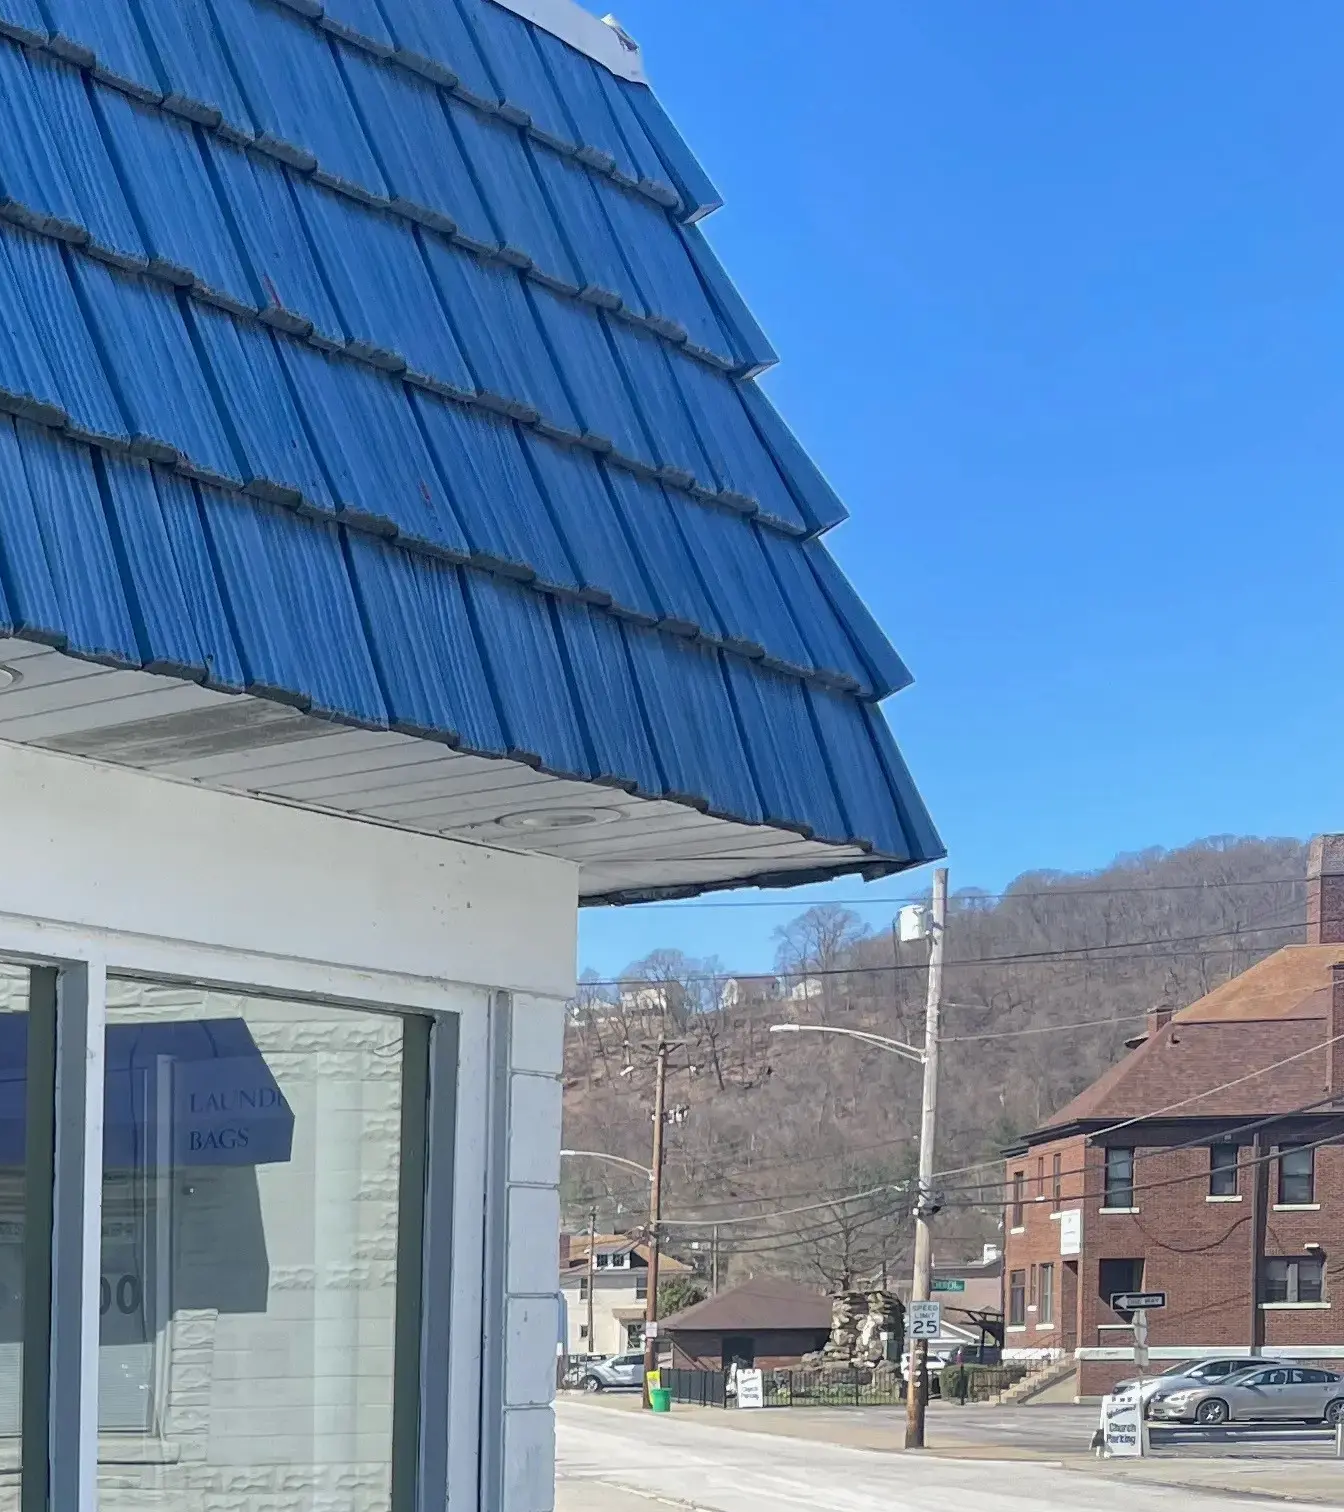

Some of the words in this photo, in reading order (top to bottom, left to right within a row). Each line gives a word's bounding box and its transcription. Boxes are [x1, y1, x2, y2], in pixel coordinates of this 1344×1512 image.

[189, 1127, 249, 1151] BAGS
[912, 1320, 937, 1334] 25
[1109, 1423, 1137, 1432] Church
[1106, 1434, 1136, 1446] Parking
